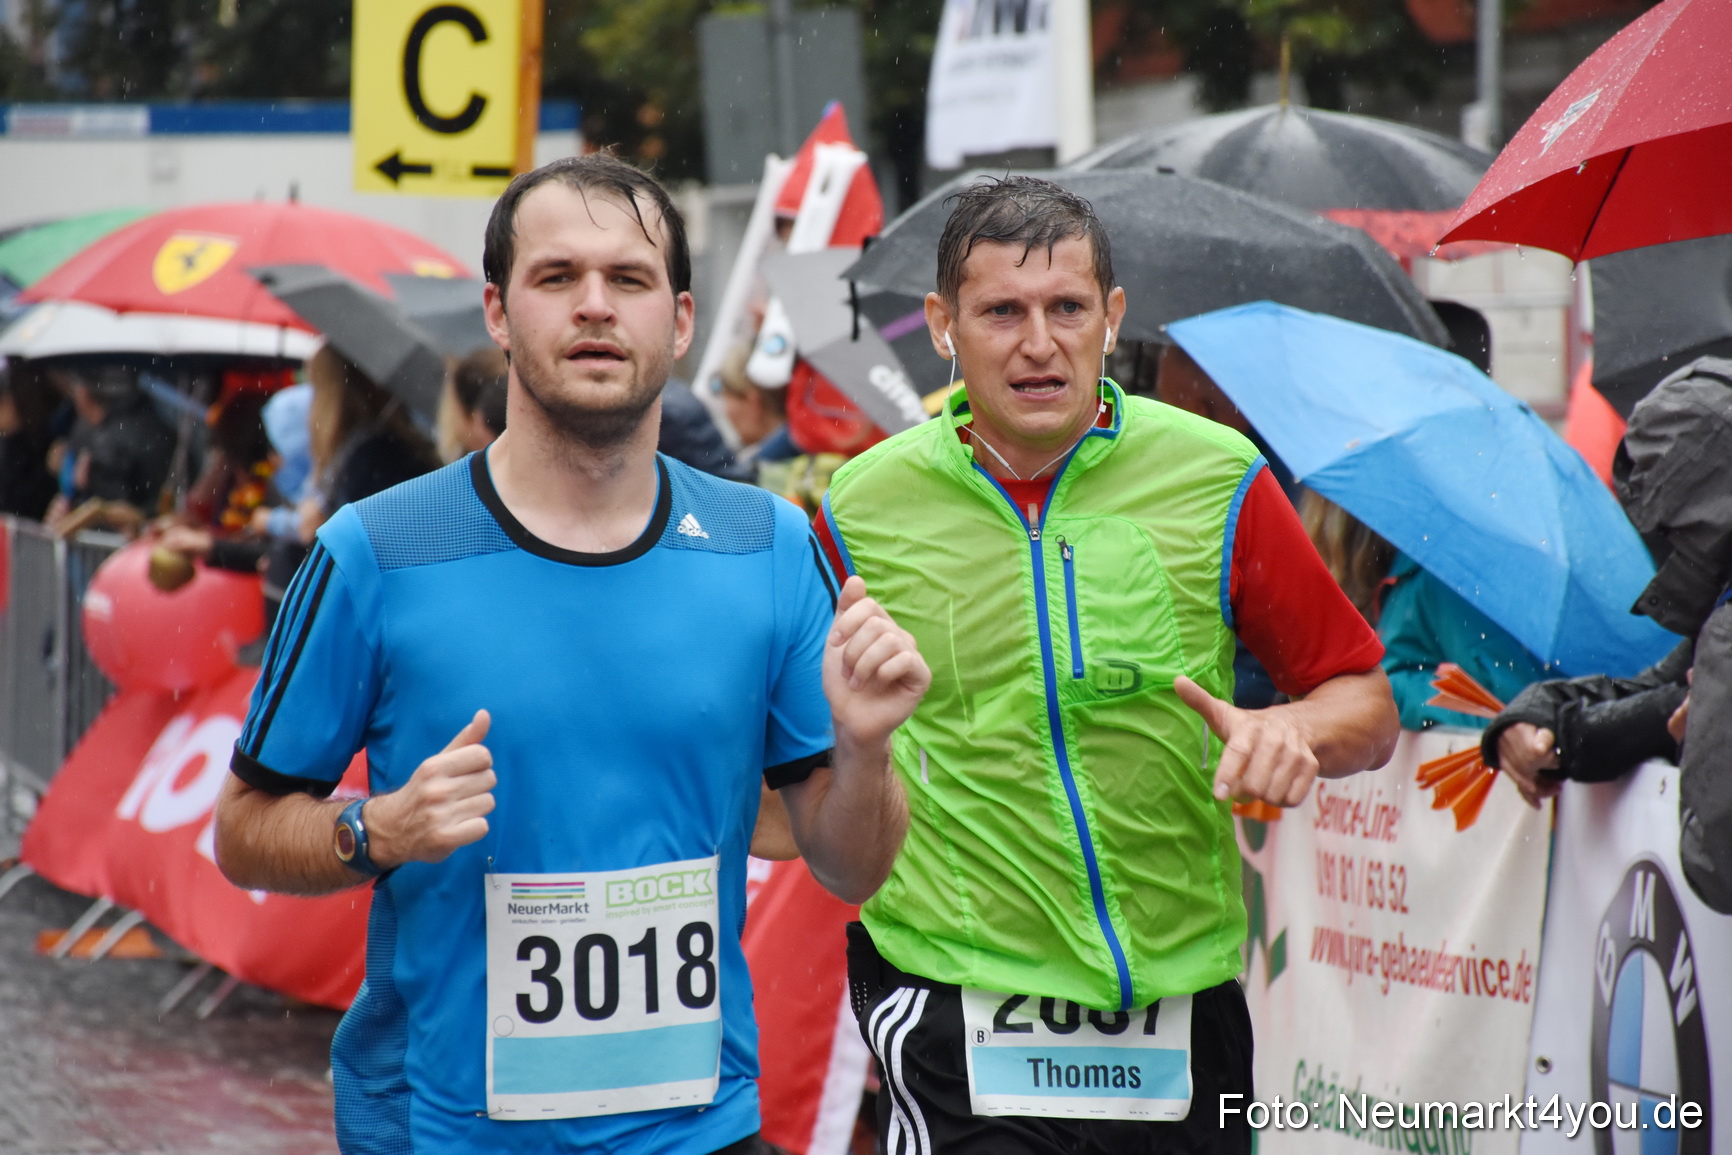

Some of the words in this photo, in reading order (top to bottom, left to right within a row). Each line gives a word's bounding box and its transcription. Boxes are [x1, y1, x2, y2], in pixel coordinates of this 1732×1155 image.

[404, 3, 490, 135] C
[508, 903, 589, 915] NeuerMarkt
[605, 868, 713, 909] BOCK
[1597, 869, 1698, 1028] BMW
[515, 921, 717, 1024] 3018
[976, 1030, 985, 1043] B
[1026, 1057, 1142, 1089] Thomas
